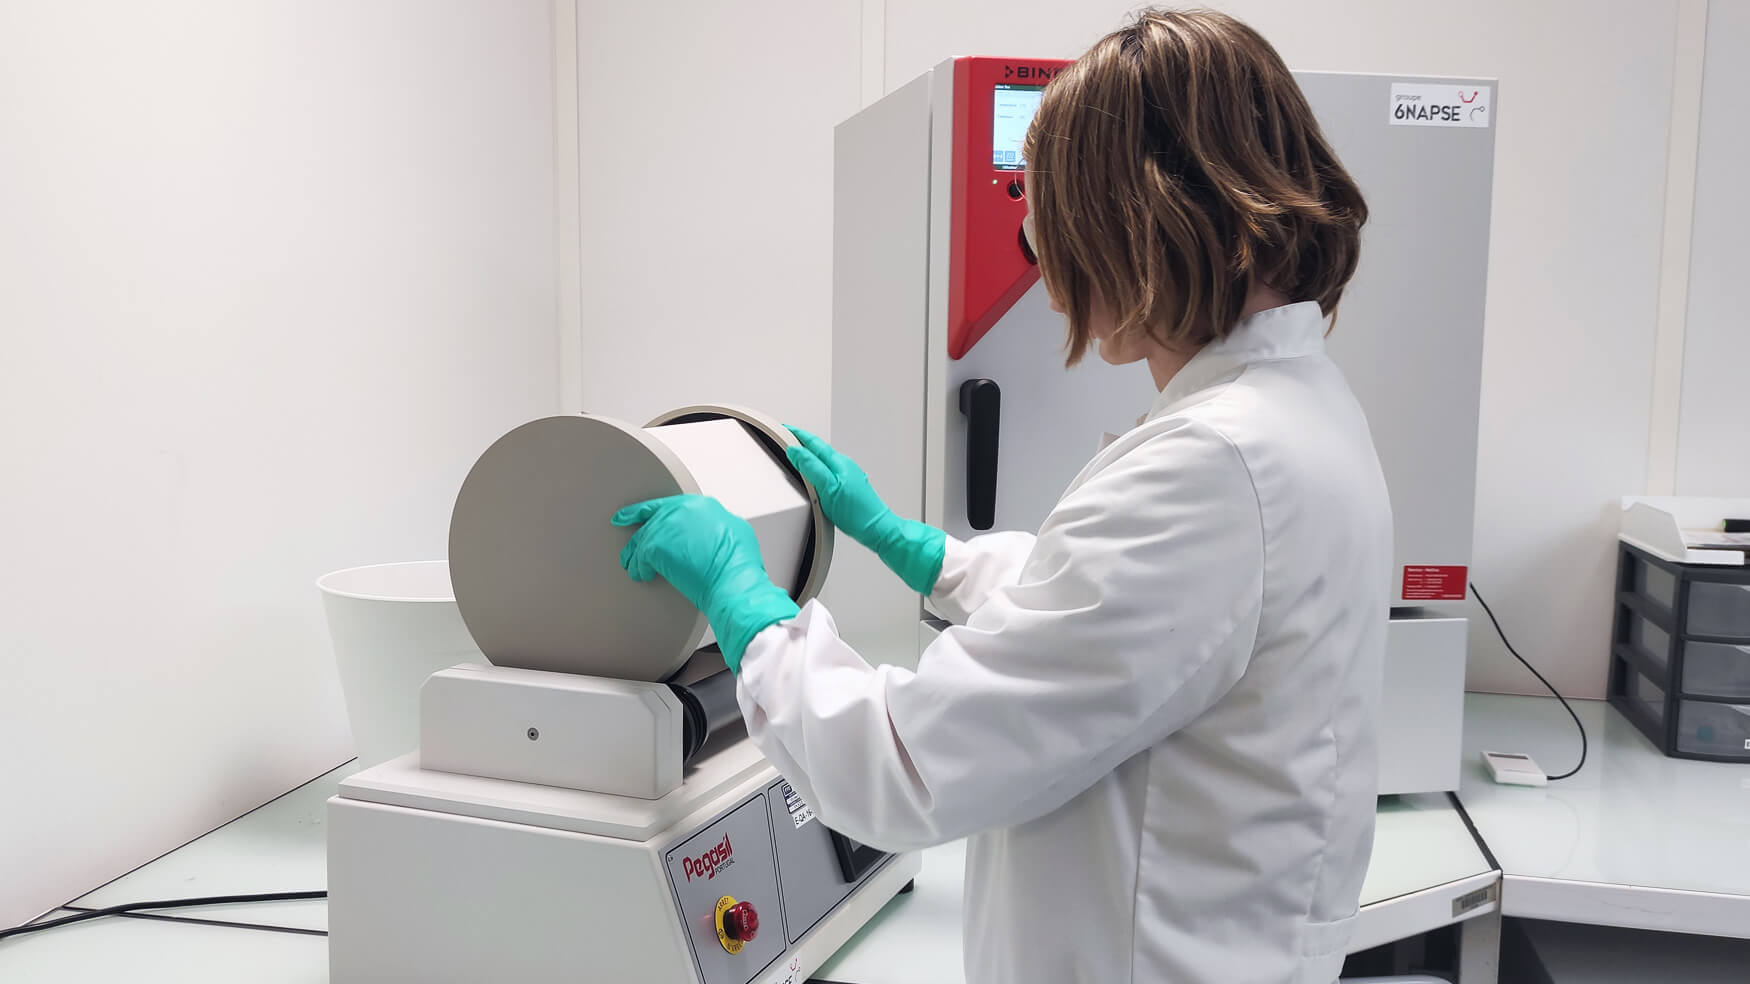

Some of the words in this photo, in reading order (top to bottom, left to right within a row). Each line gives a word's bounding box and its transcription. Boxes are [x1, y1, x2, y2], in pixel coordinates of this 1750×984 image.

[1395, 94, 1422, 102] groupe
[1394, 103, 1462, 121] 6NAPSE
[682, 832, 733, 883] Pegasil
